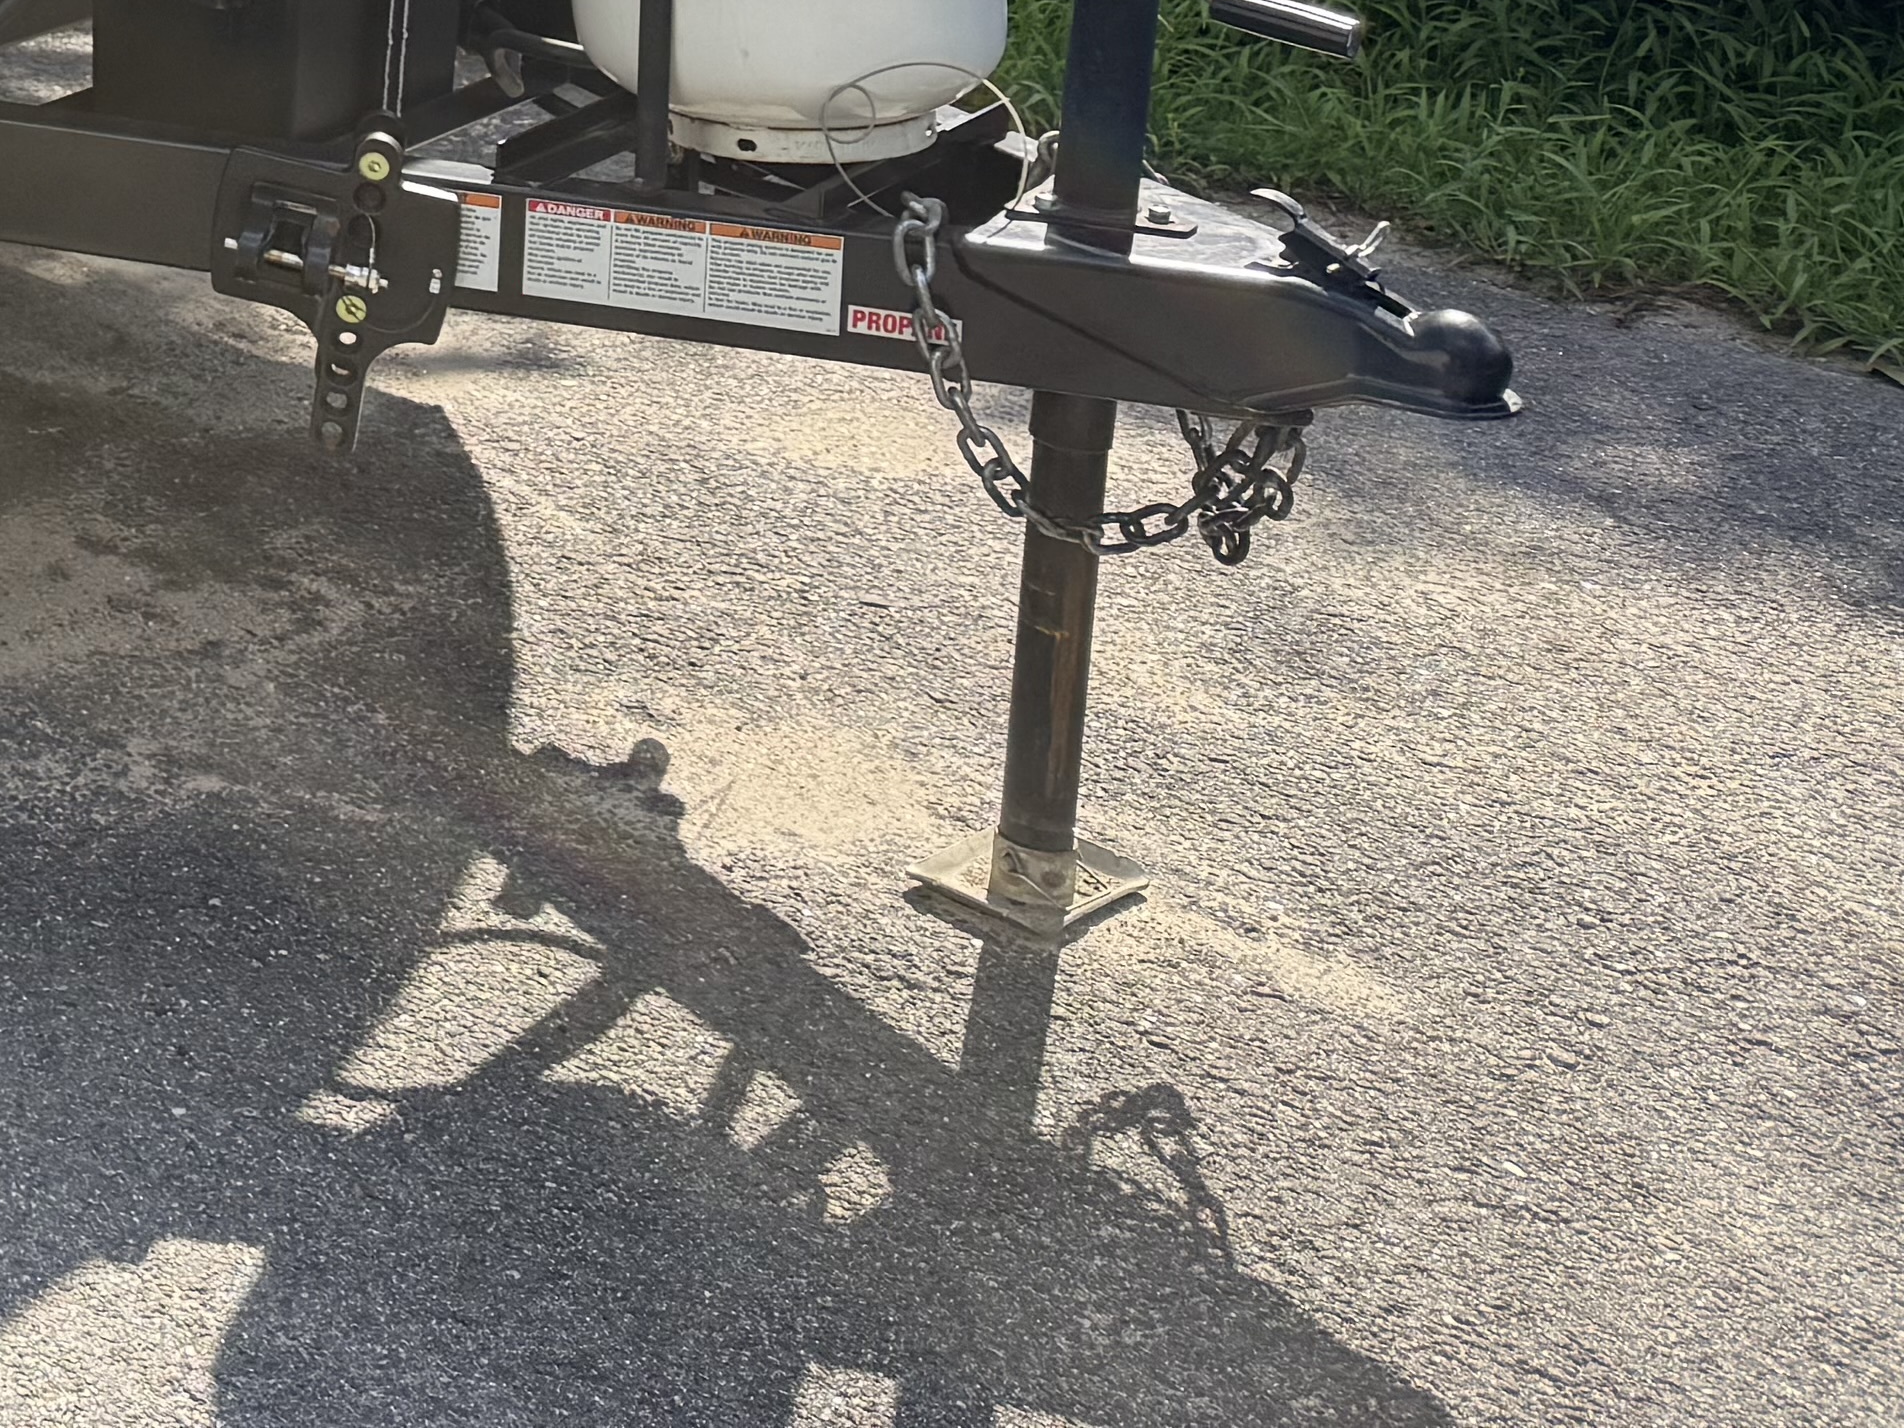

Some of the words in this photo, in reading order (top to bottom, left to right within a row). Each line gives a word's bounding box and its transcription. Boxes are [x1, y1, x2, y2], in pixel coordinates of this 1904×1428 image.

[547, 204, 605, 220] DANGER
[633, 214, 696, 232] WARNING
[751, 228, 812, 246] WARNING
